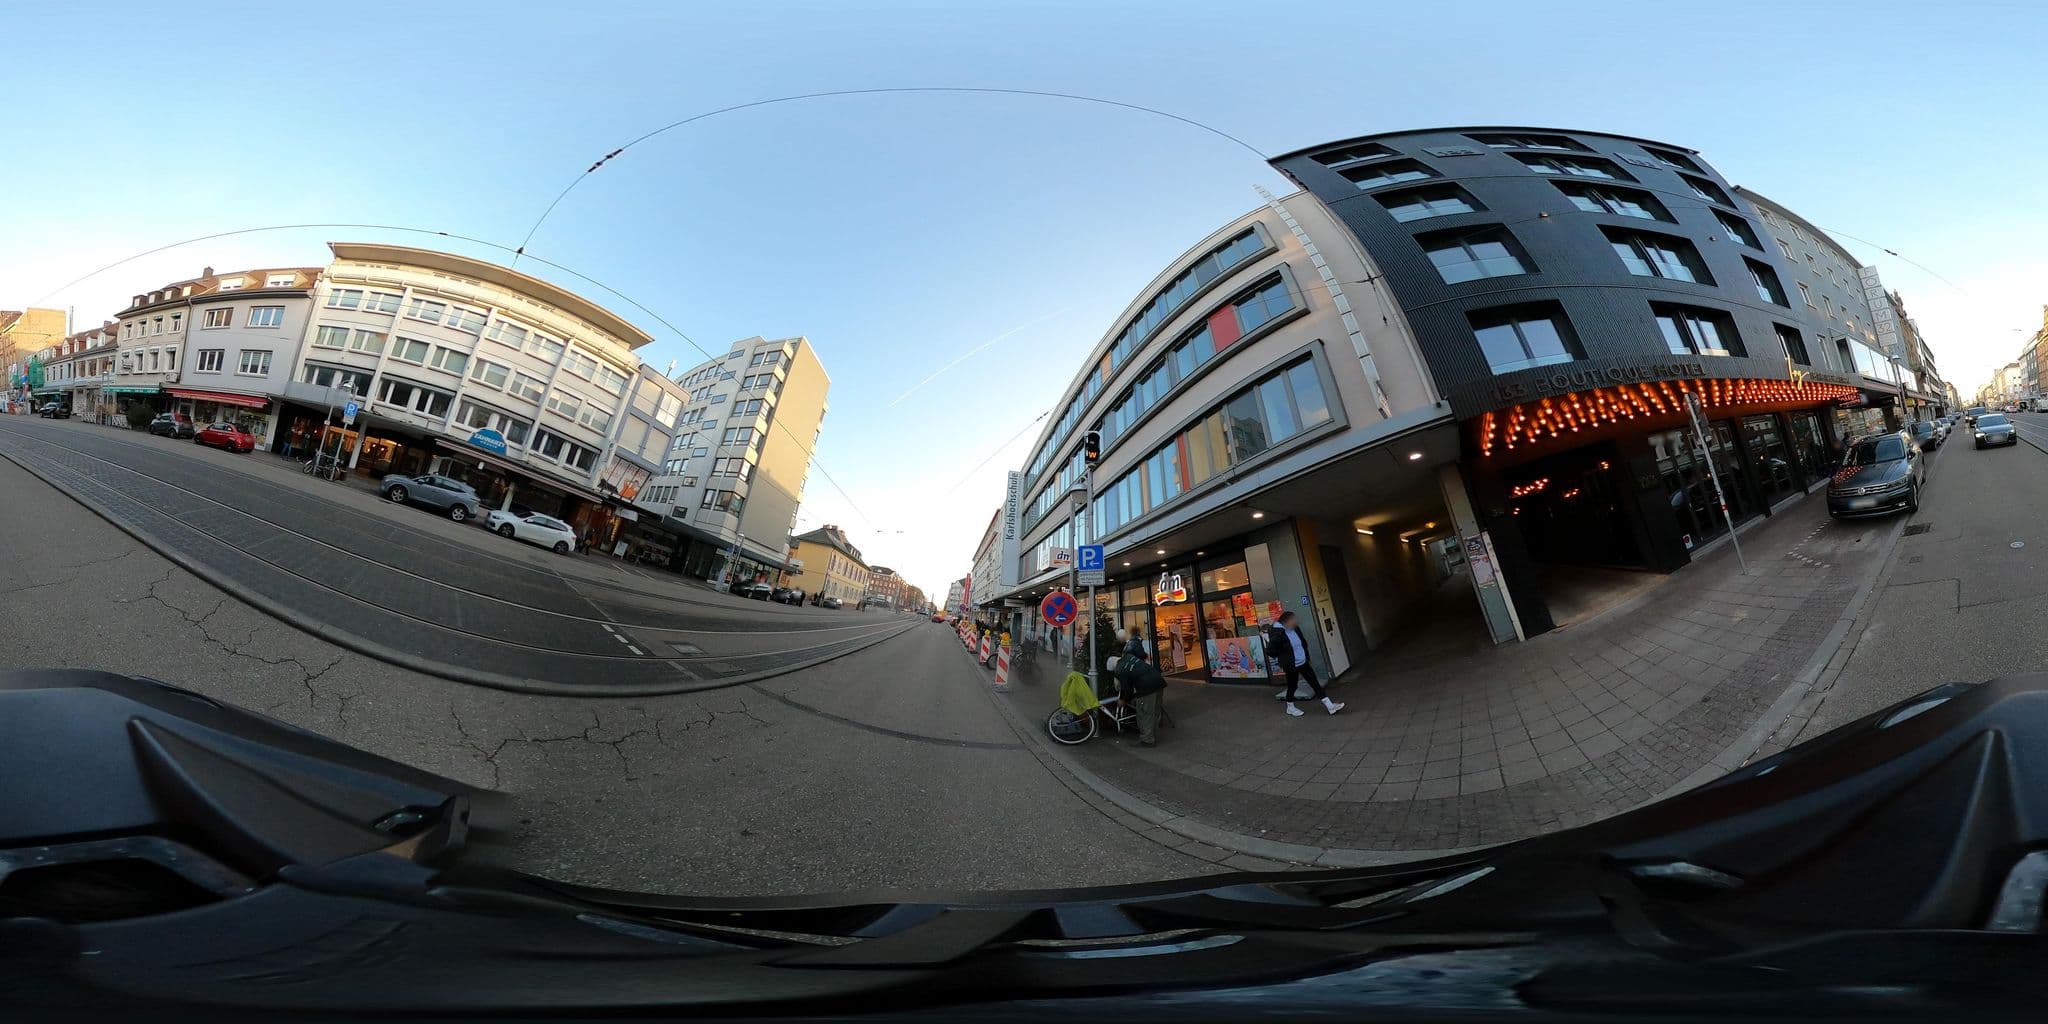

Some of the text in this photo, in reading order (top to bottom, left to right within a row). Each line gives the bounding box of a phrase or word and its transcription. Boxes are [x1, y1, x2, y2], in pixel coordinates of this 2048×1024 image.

[1536, 364, 1652, 392] BOUTIQUE
[1653, 362, 1706, 379] HOTEL
[1005, 471, 1019, 541] Karlshochschule
[1082, 548, 1096, 567] P
